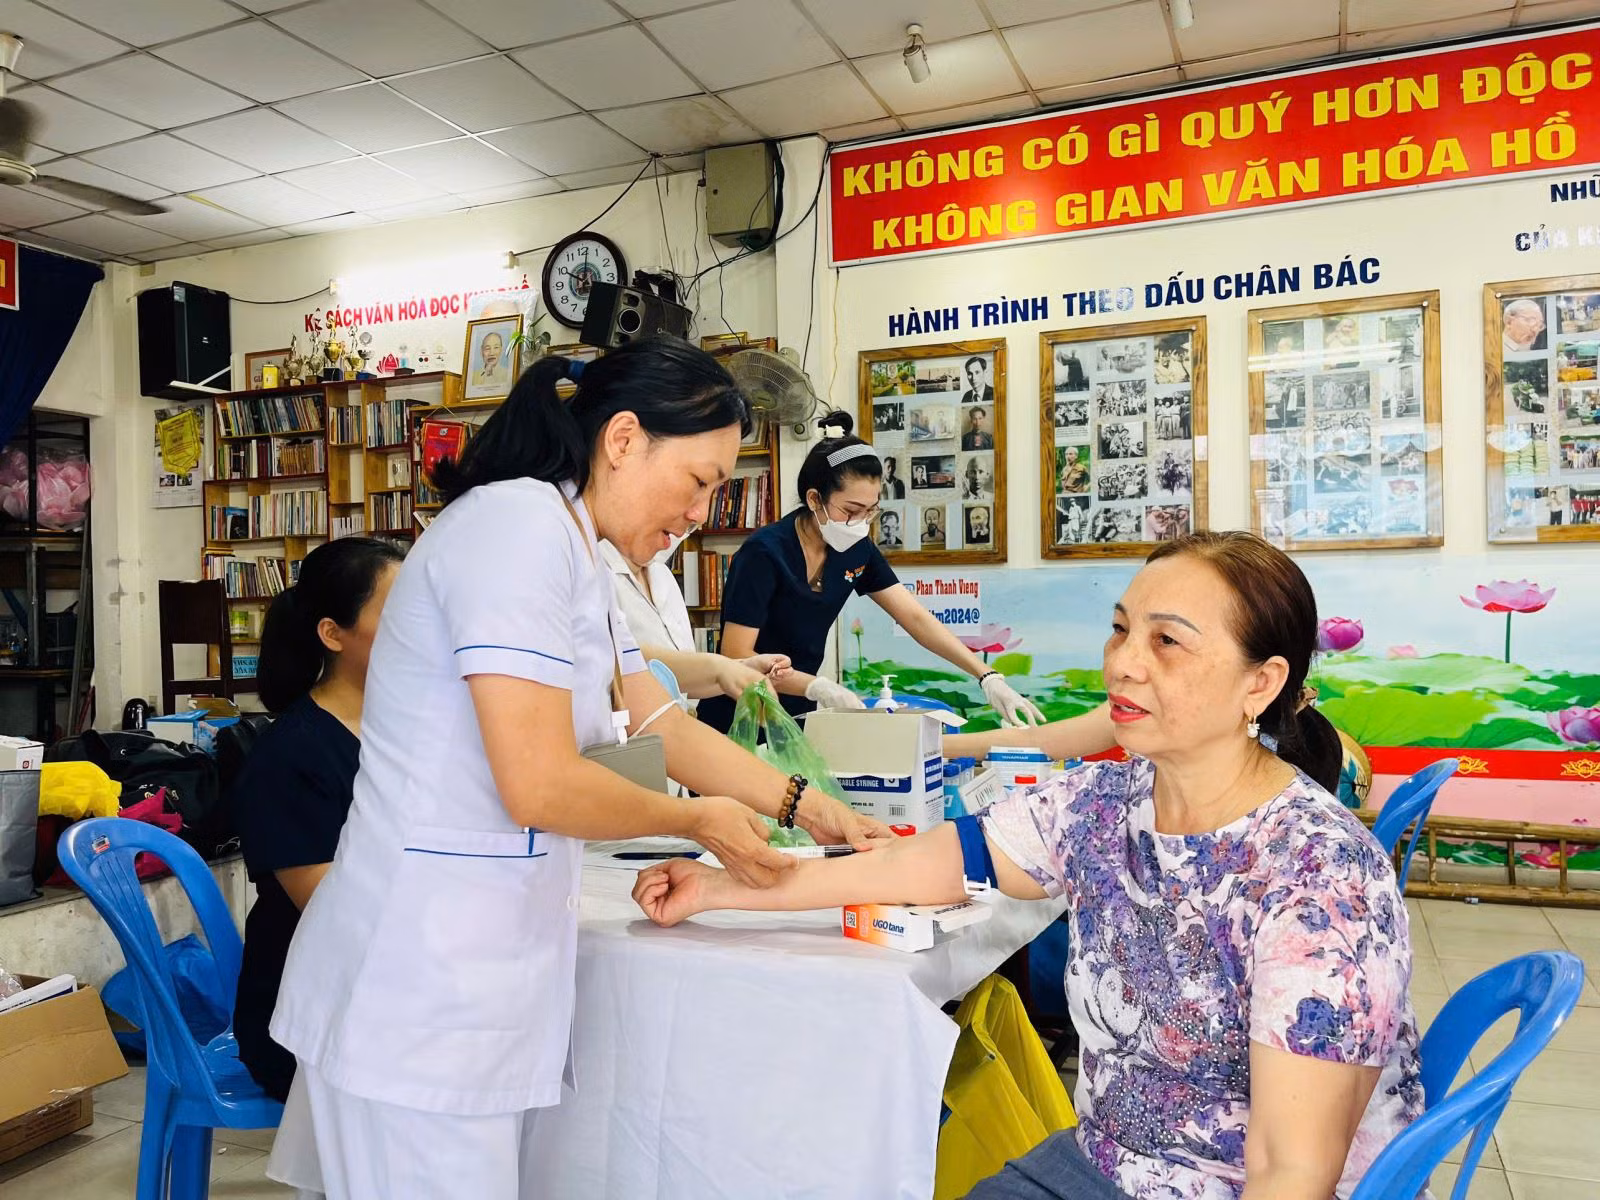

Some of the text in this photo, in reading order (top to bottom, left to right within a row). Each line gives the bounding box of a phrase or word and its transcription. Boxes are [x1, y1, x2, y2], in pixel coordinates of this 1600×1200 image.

[843, 52, 1592, 197] KHÔNG CÓ GÌ QUÝ HƠN ĐỘC
[873, 111, 1576, 250] KHÔNG GIAN VĂN HÓA HỒ
[577, 246, 589, 256] 12
[326, 303, 362, 329] SÁCH
[430, 294, 460, 319] ĐỌC
[888, 254, 1380, 337] HÀNH TRÌNH THEO DẤU CHÂN BÁC
[916, 579, 933, 596] Phan
[935, 578, 957, 595] Thanh
